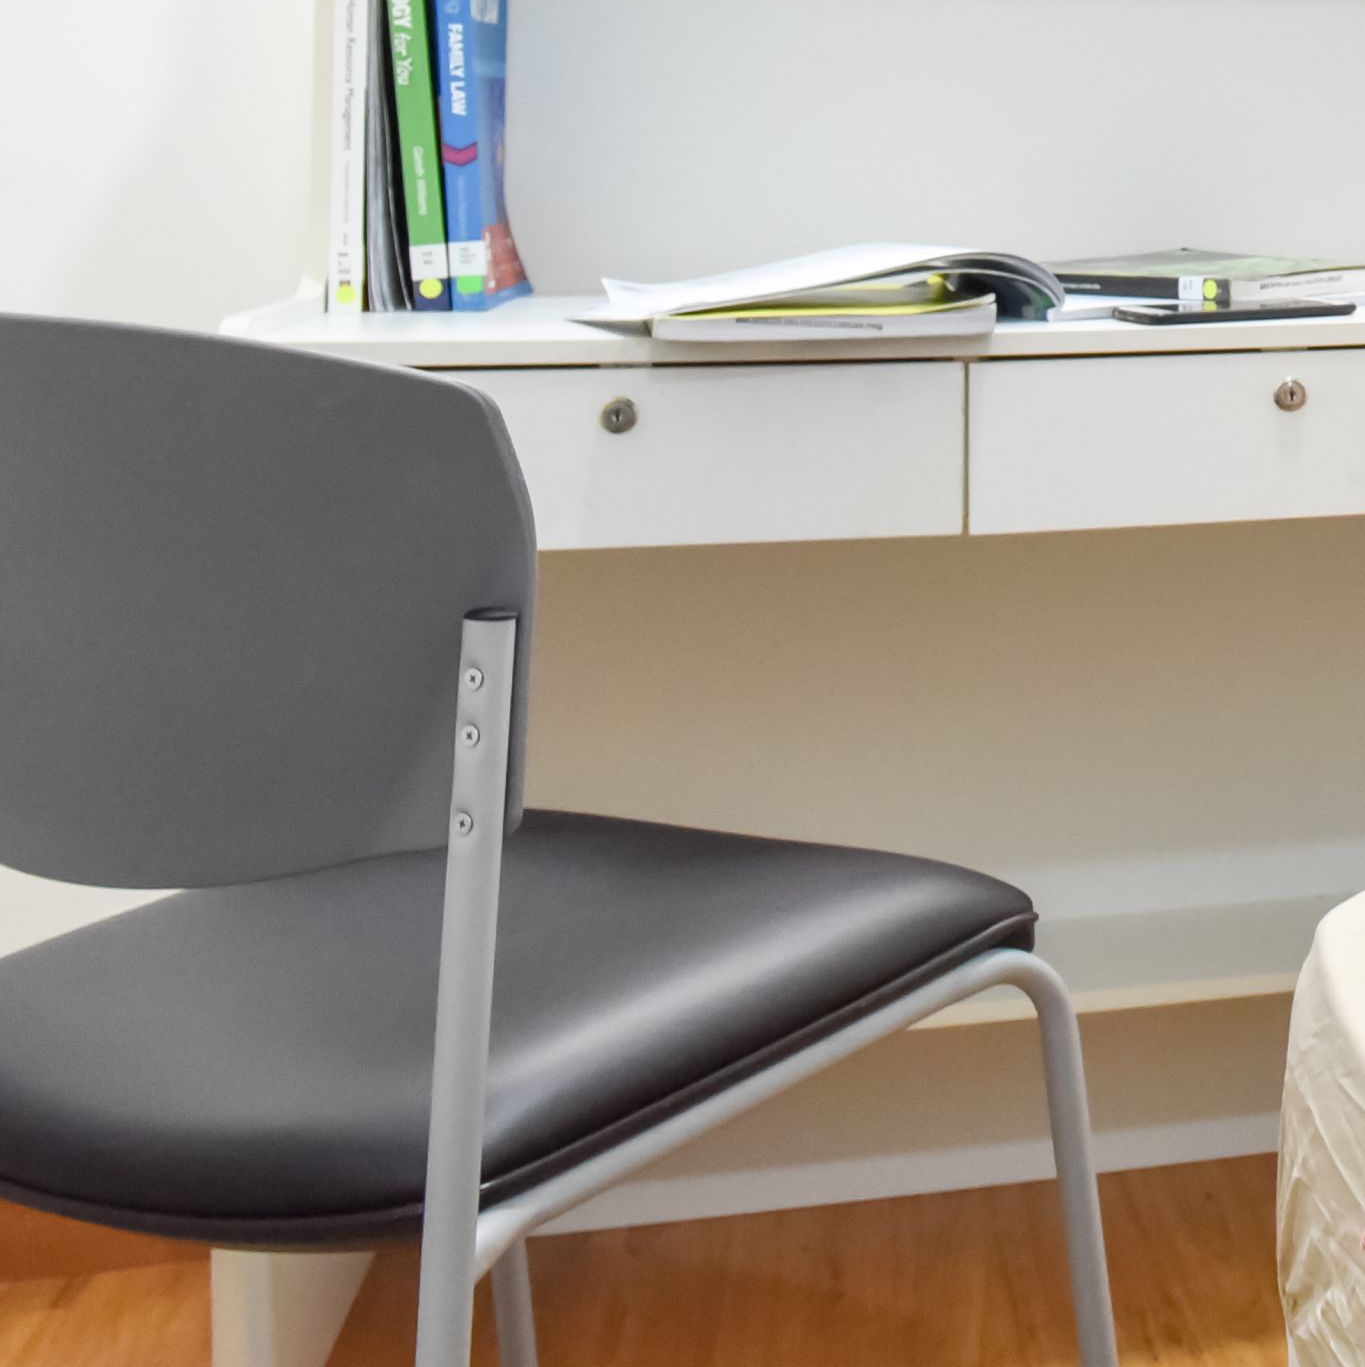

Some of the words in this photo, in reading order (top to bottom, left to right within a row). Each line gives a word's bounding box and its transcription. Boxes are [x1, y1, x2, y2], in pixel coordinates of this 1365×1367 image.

[394, 32, 412, 57] for
[448, 23, 465, 78] FAMILY
[396, 57, 414, 86] You
[450, 81, 467, 116] LAW
